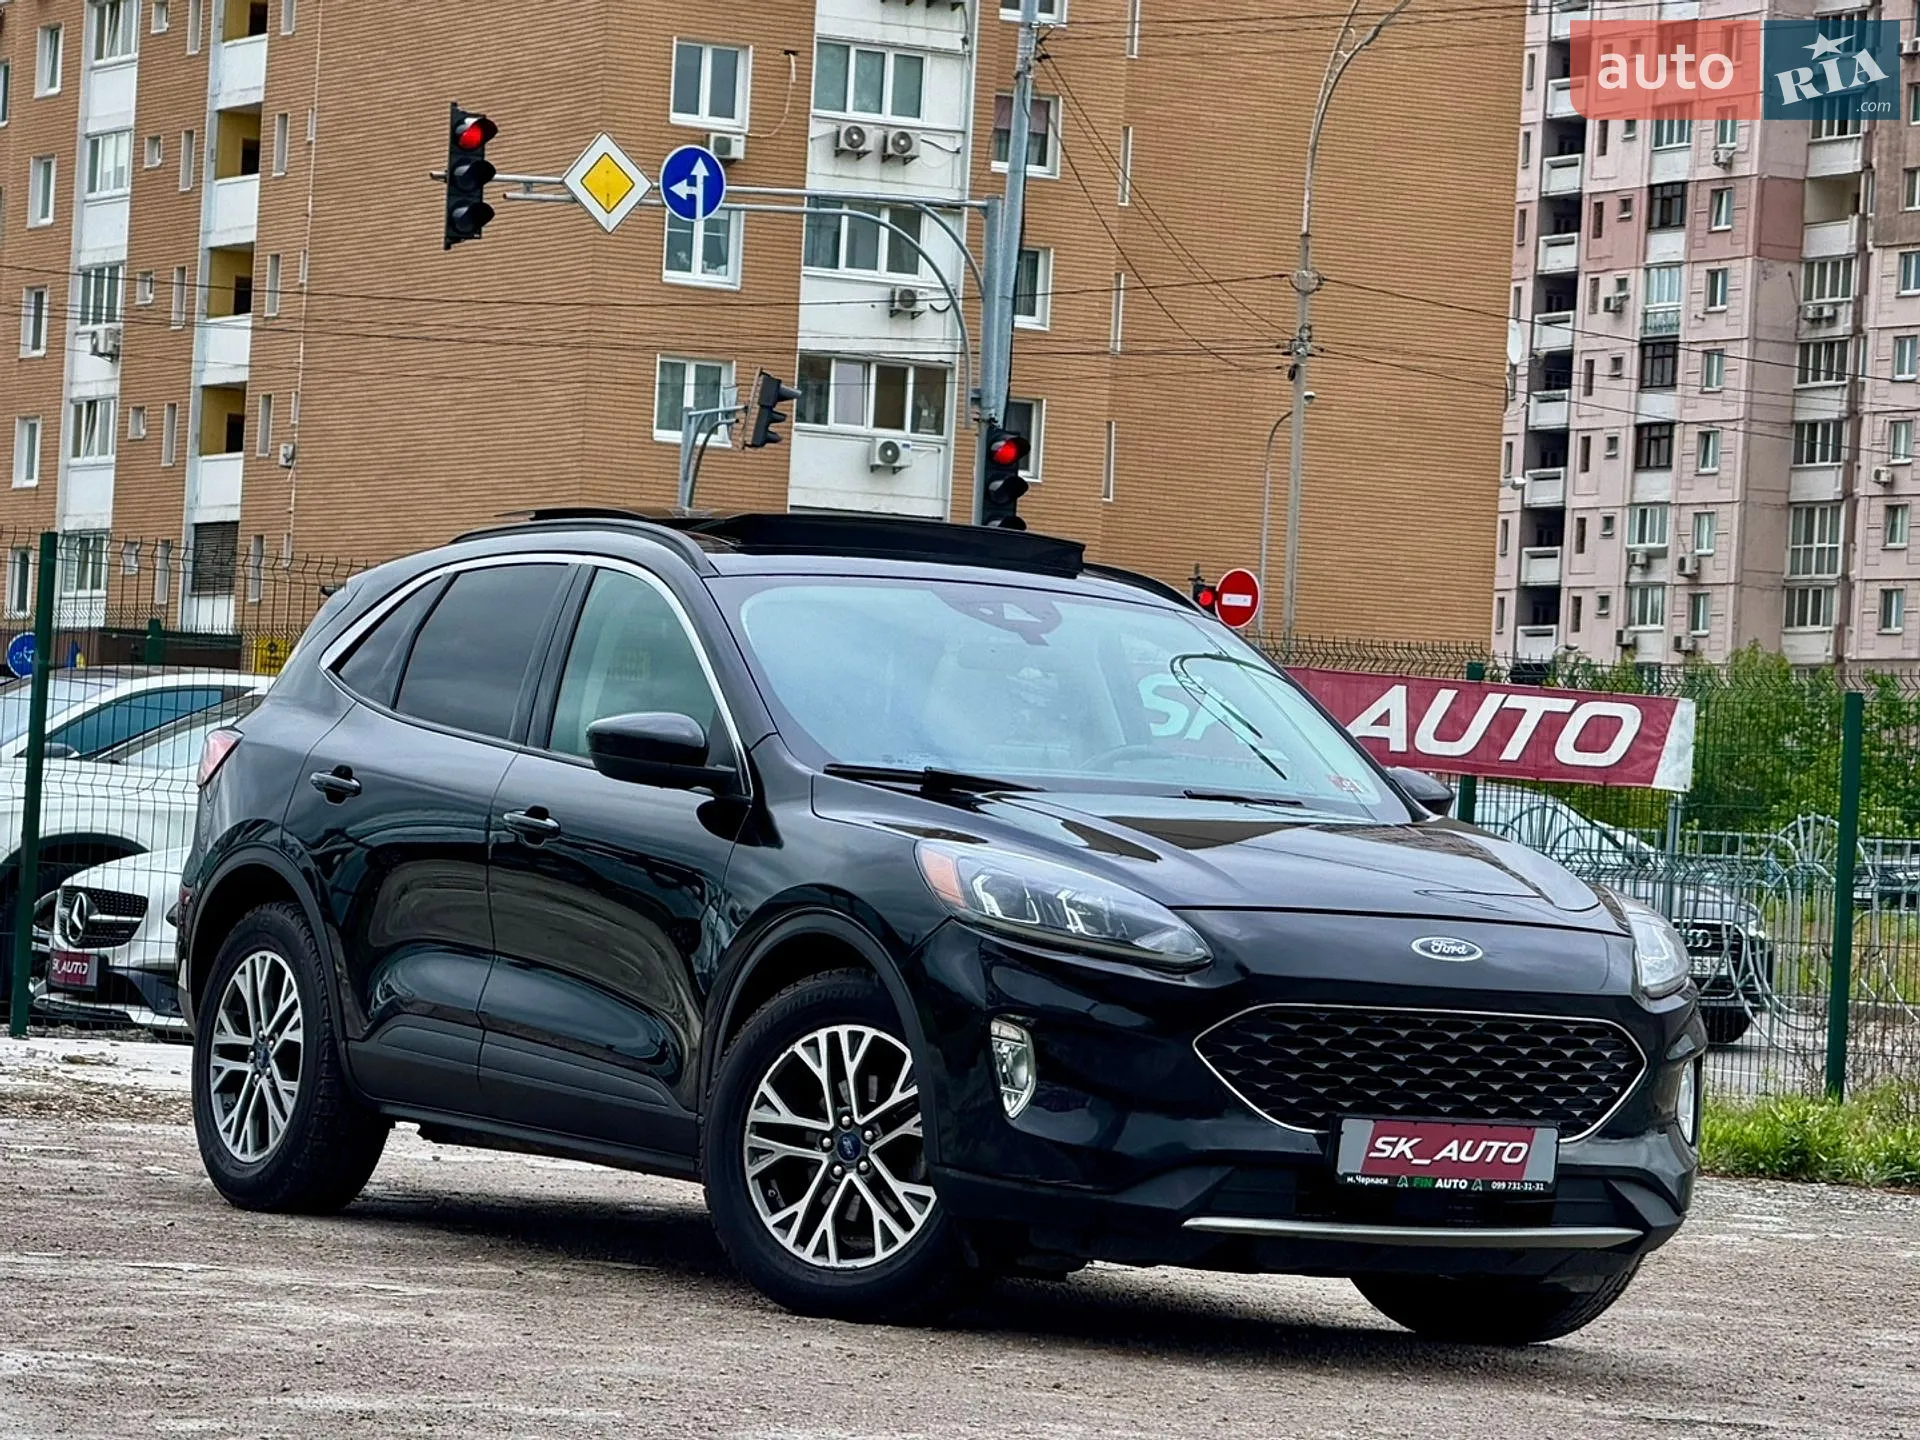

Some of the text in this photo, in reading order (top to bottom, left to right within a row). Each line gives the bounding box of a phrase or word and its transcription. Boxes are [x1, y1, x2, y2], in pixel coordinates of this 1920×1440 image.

[1430, 940, 1468, 954] Ford
[1368, 1136, 1529, 1165] SK_AUTO
[1435, 1178, 1468, 1189] AUTO
